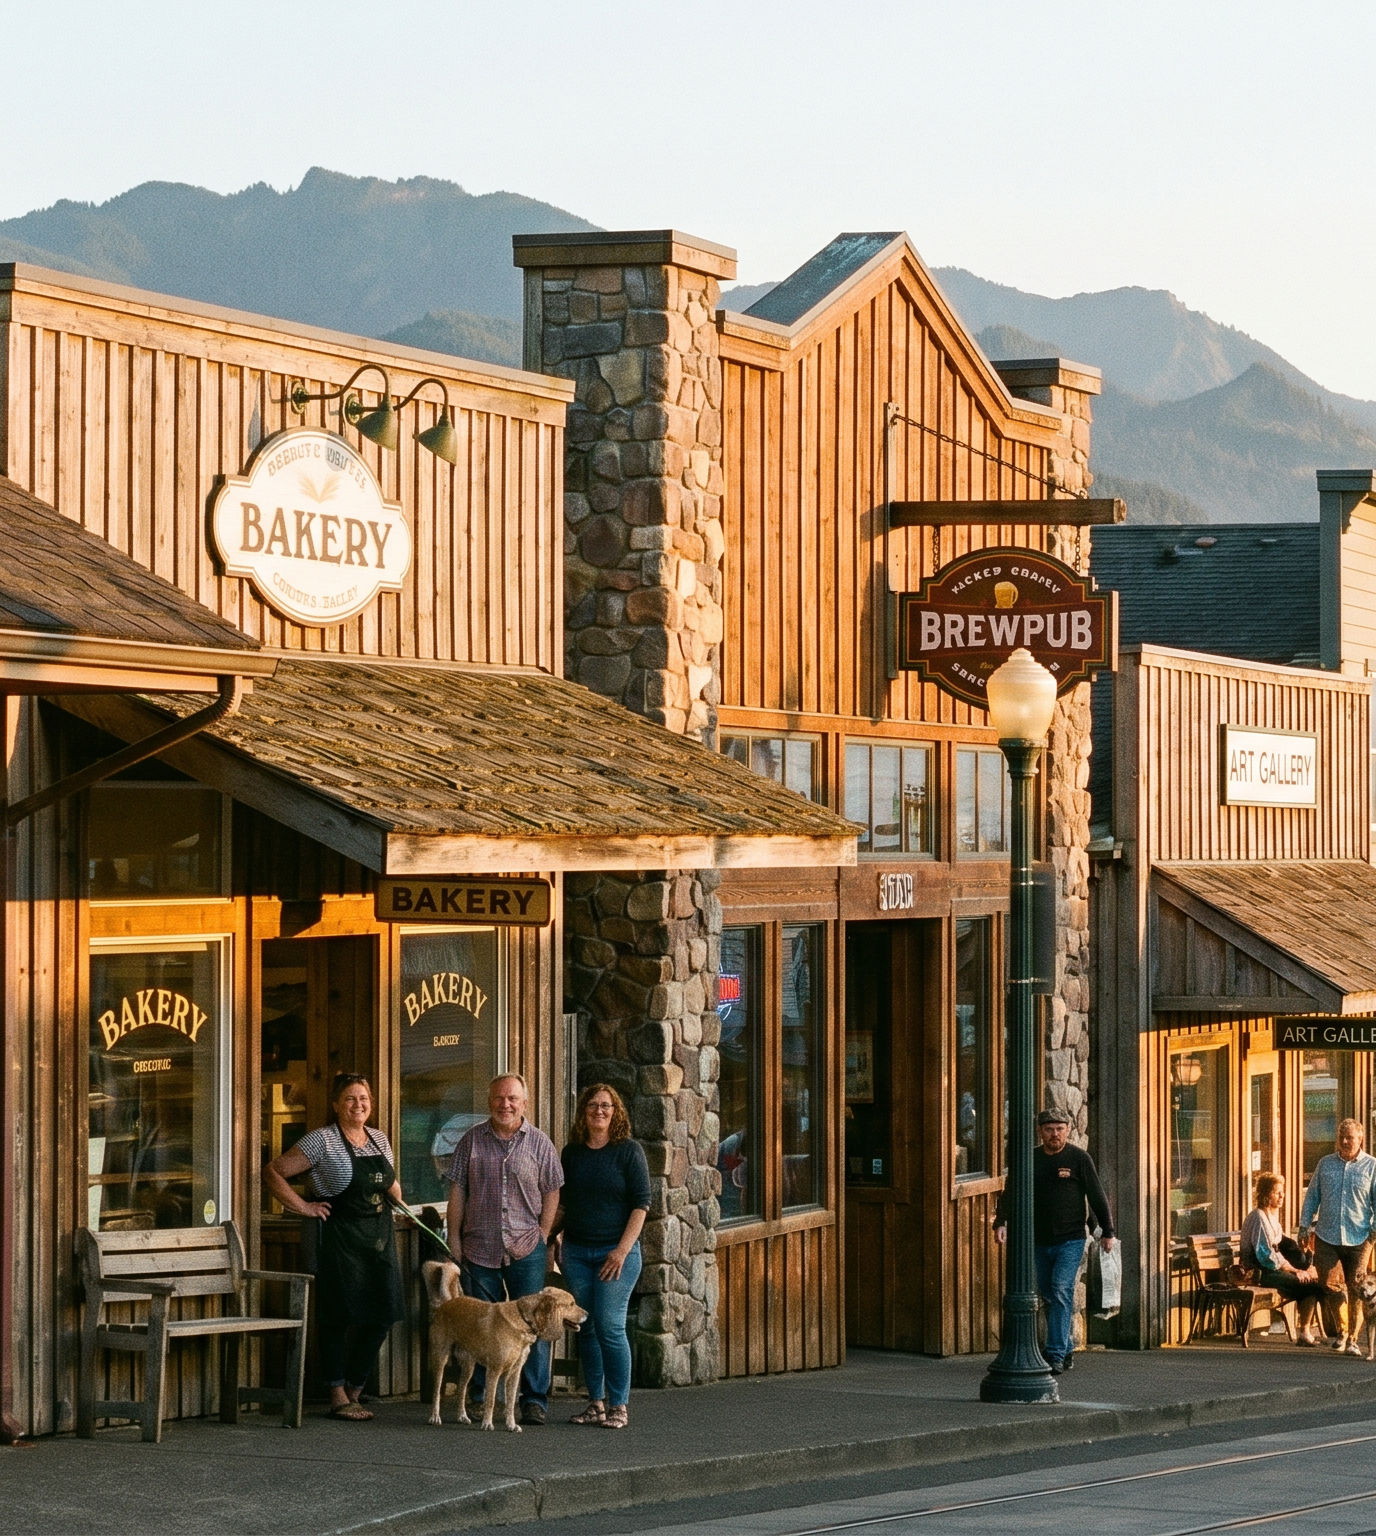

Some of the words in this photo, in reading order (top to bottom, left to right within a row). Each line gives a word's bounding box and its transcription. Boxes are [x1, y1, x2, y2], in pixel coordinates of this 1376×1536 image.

[239, 501, 393, 570] BAKERY
[919, 610, 1093, 651] BREWPUB
[1229, 749, 1255, 783] ART
[1258, 751, 1312, 787] GALLERY
[392, 886, 535, 916] BAKERY
[97, 988, 208, 1051] BAKERY
[403, 972, 488, 1027] BAKERY
[1283, 1026, 1318, 1043] ART
